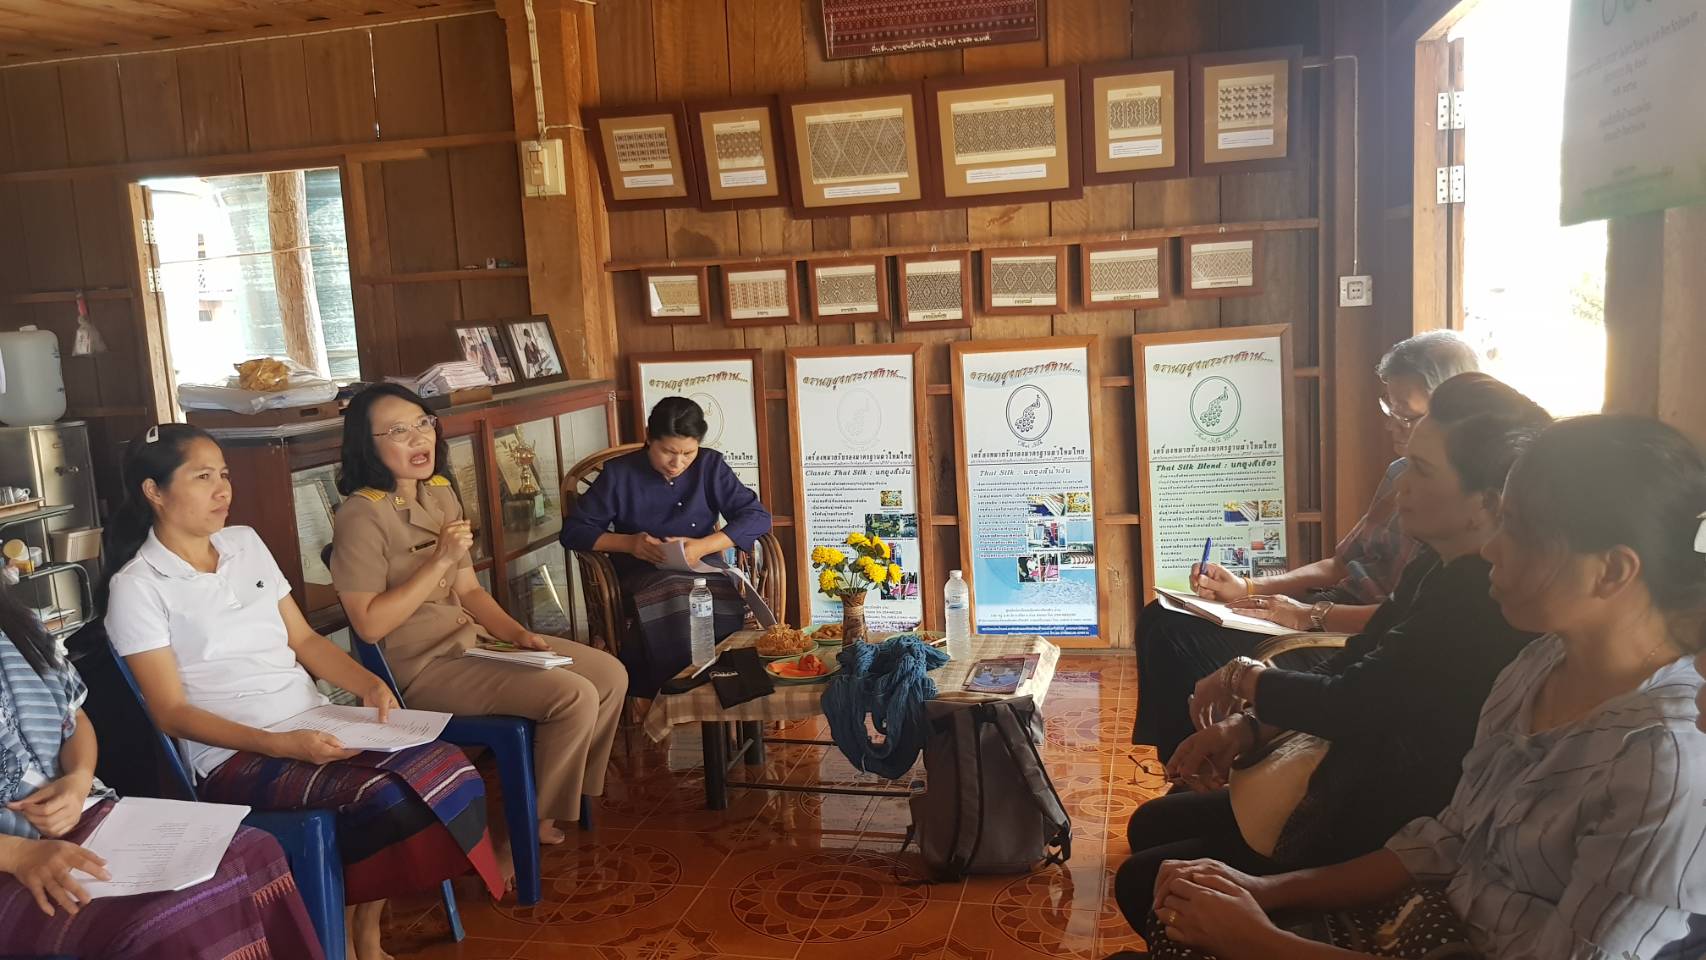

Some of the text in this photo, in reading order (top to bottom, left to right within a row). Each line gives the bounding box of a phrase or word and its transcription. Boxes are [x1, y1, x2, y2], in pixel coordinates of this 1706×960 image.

[1156, 463, 1175, 472] Thai
[1177, 462, 1195, 471] Silk
[1197, 461, 1221, 471] Blend
[805, 468, 832, 477] Classic
[834, 468, 850, 476] Thai
[852, 467, 867, 476] Silk
[980, 469, 997, 477] Thai
[999, 467, 1014, 476] Silk
